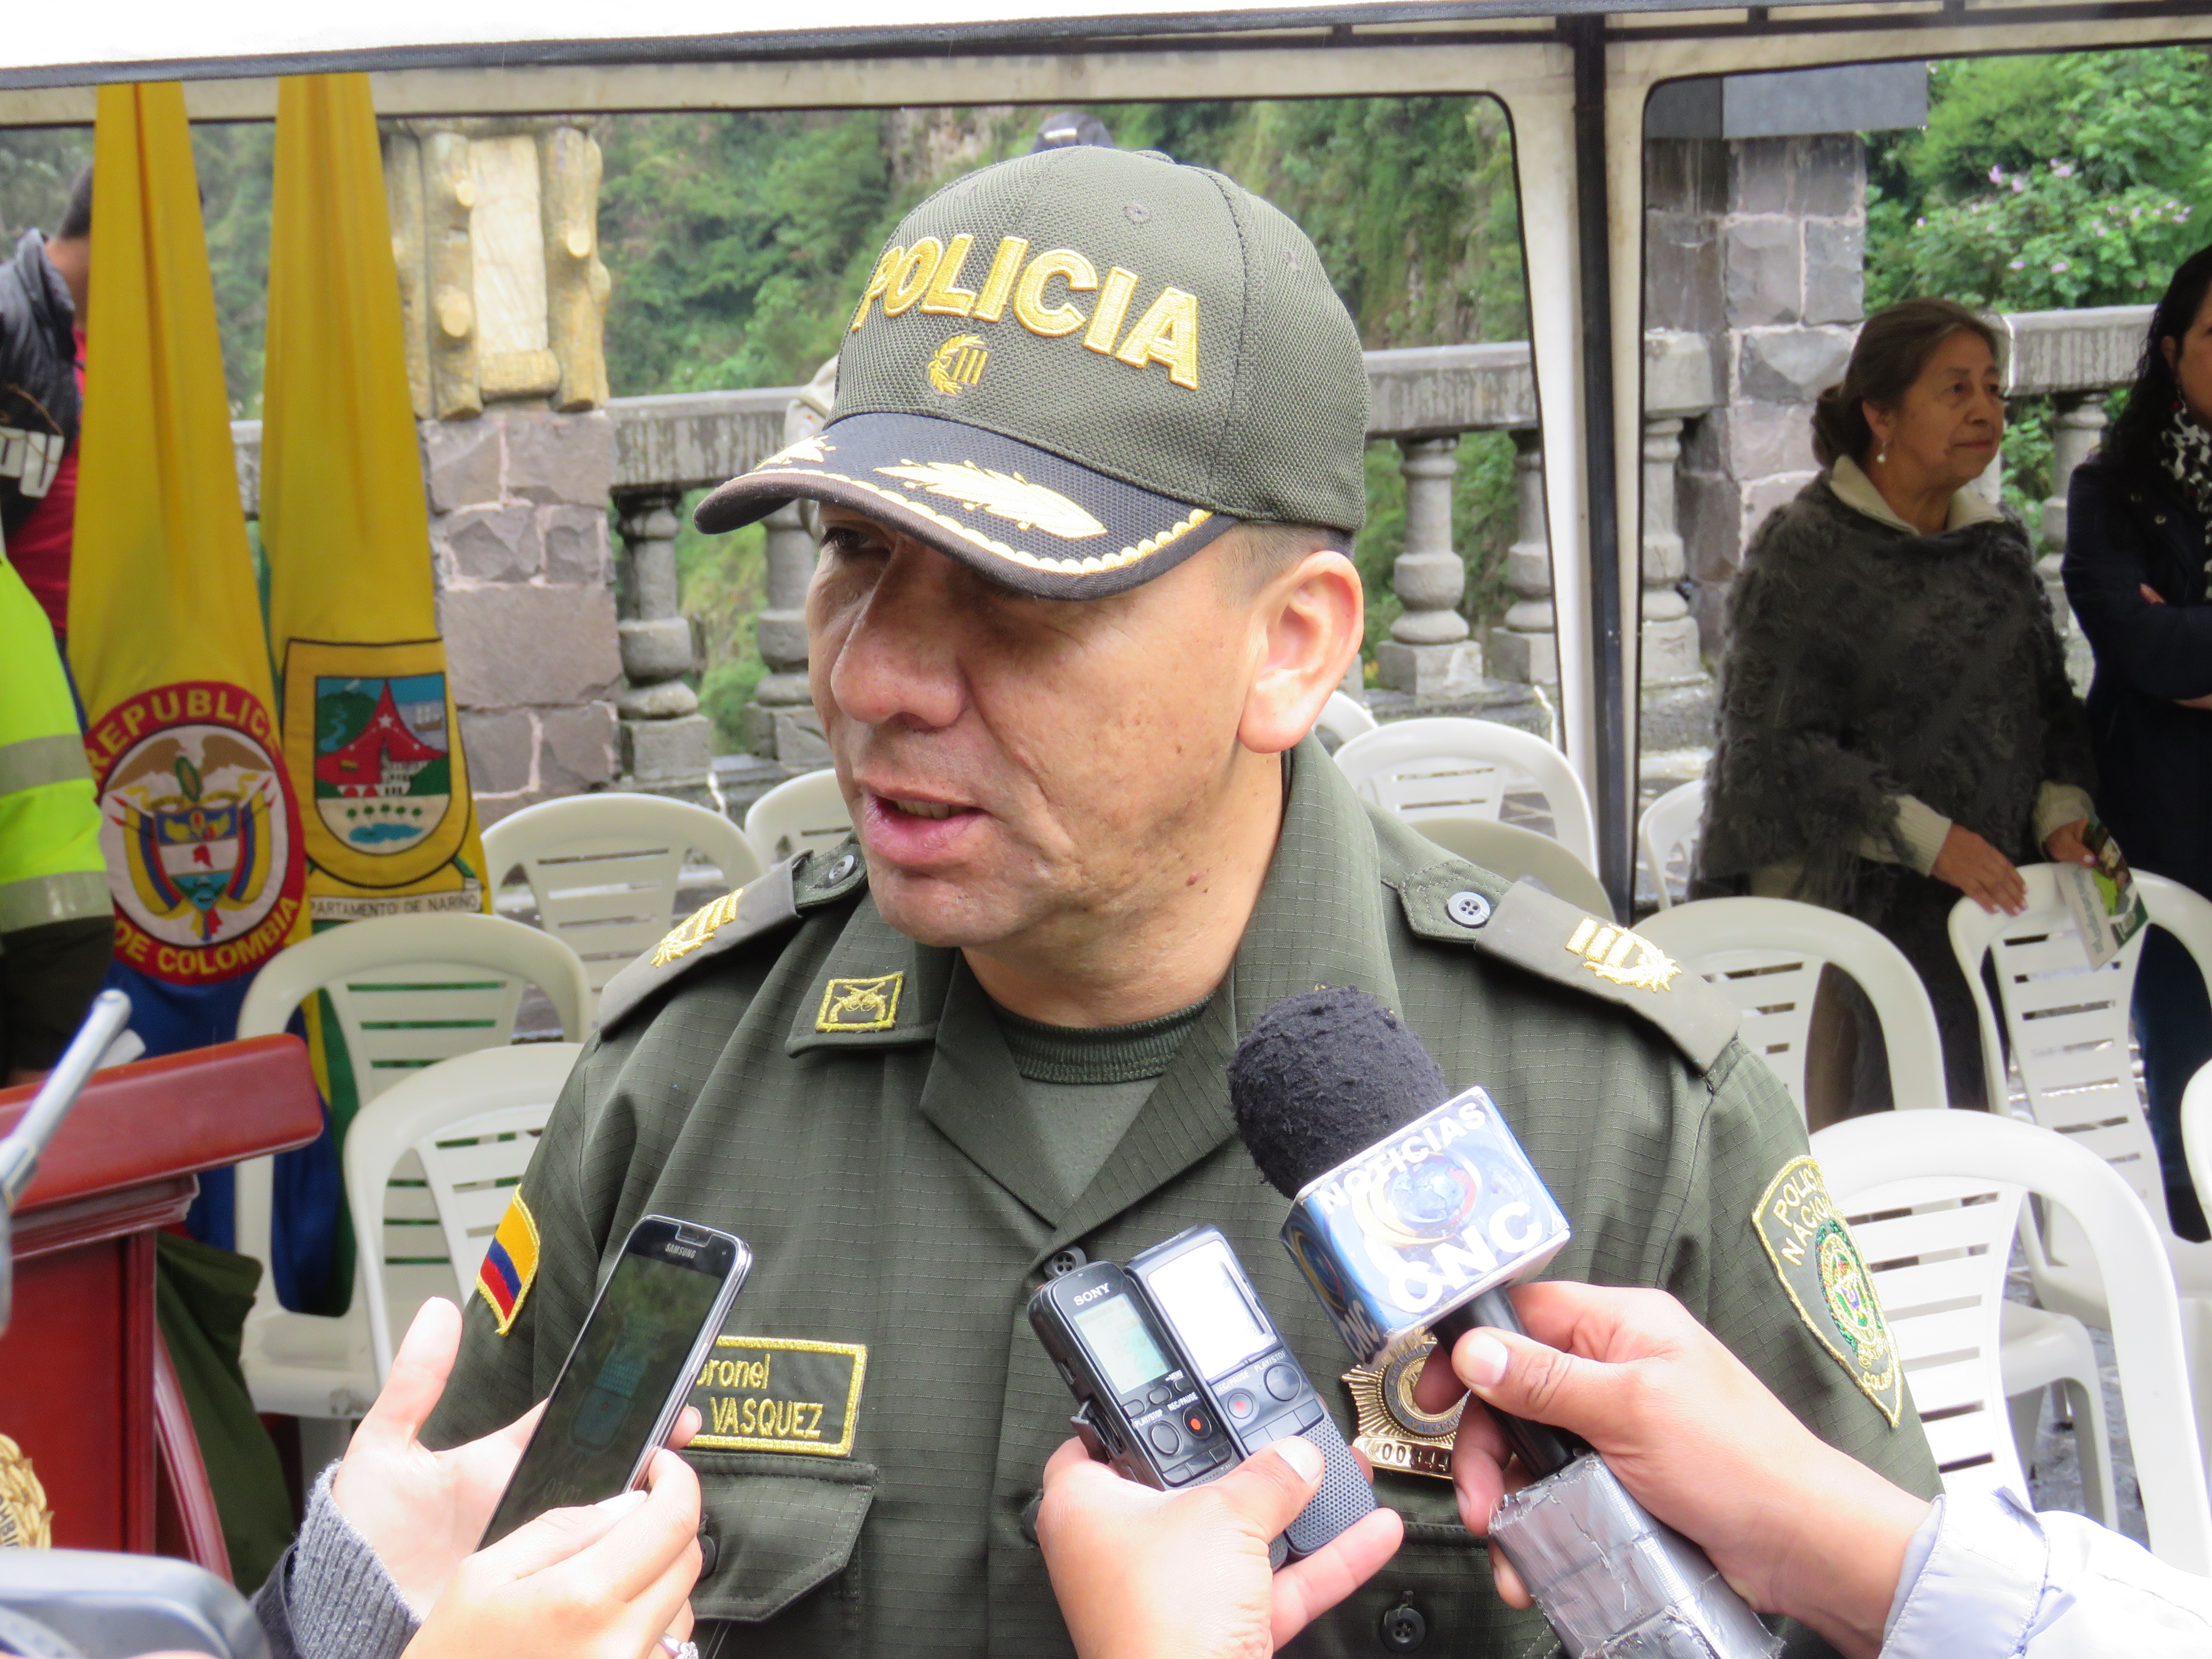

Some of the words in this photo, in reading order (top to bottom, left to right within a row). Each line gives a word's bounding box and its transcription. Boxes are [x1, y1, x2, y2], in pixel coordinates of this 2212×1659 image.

[850, 233, 1199, 390] POLICIA
[404, 900, 421, 913] DE
[114, 919, 152, 962] DE
[156, 897, 299, 975] COLOMBIA
[1316, 1102, 1486, 1215] NOTICIAS
[665, 1243, 697, 1258] SAMSUNG
[1073, 1283, 1110, 1306] SONY
[1167, 1392, 1199, 1411] REC/PAUSE
[709, 1396, 824, 1439] VASQUEZ
[1134, 1408, 1163, 1428] PLAY/STOP
